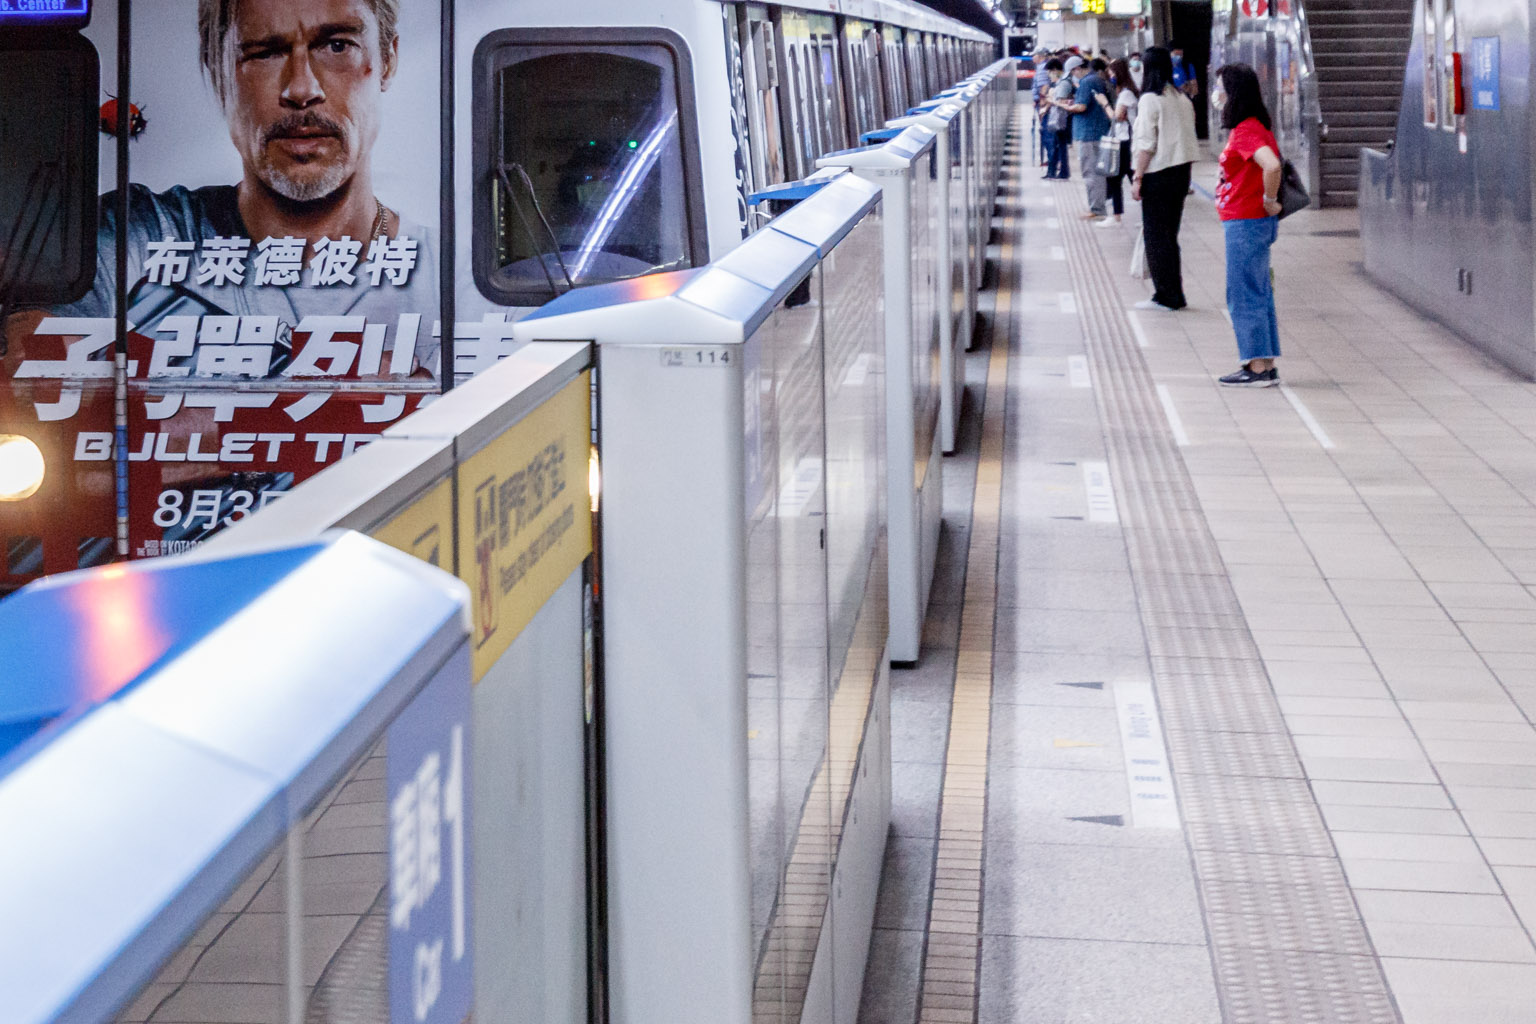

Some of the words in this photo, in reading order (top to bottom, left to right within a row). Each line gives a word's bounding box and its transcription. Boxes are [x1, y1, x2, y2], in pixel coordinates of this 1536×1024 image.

[144, 235, 419, 288] 布萊德彼特
[696, 350, 730, 364] 114
[74, 431, 295, 462] BULLET
